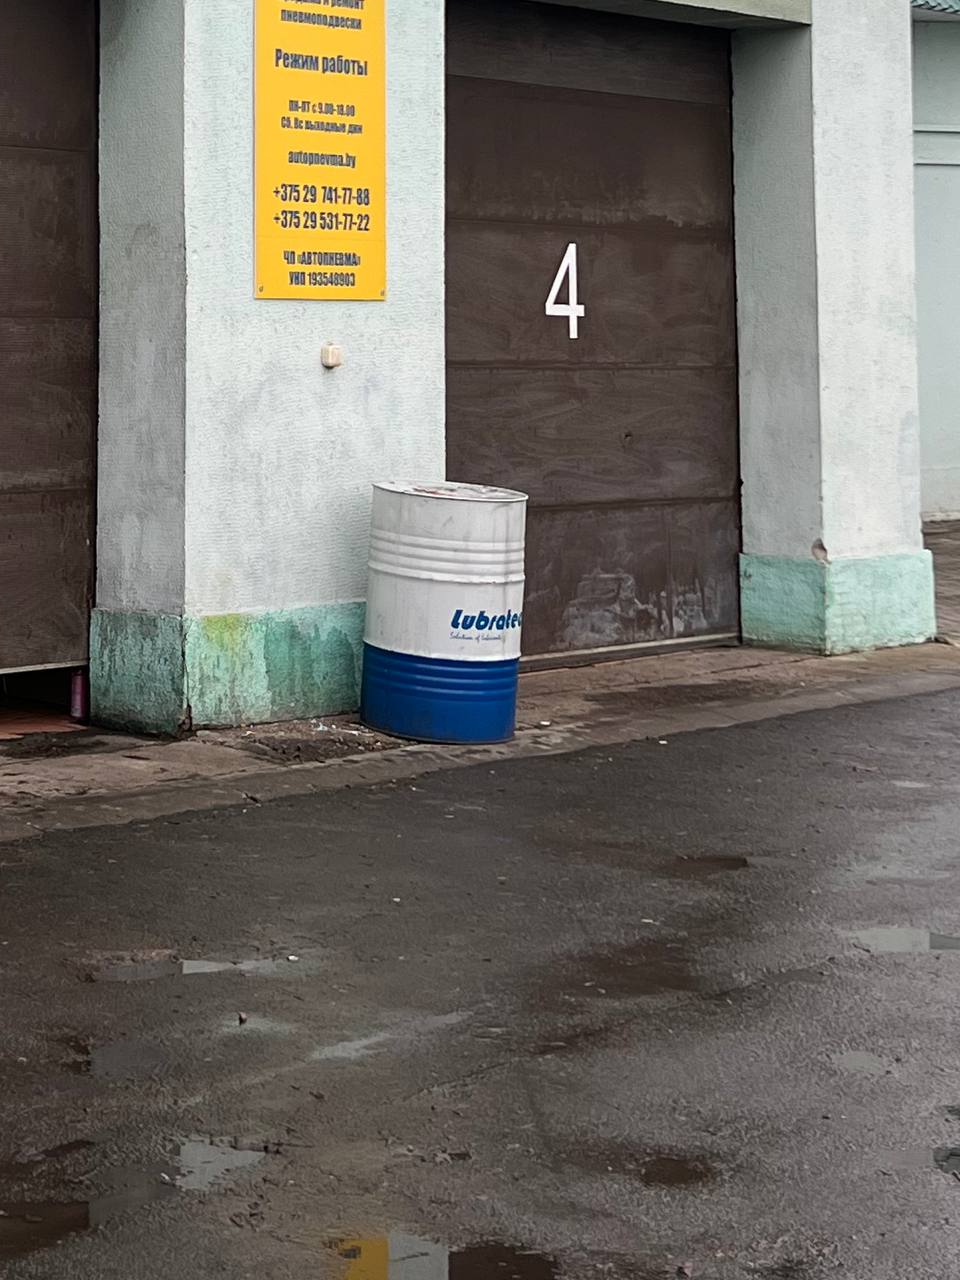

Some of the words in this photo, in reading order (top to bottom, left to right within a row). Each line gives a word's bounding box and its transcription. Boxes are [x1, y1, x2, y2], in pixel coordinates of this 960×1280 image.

[280, 9, 362, 30] пневмоподвески
[275, 48, 320, 71] Режим
[322, 55, 368, 76] работы
[304, 120, 346, 134] выходные
[347, 123, 363, 135] дни
[288, 150, 356, 168] autopnevma.by
[273, 183, 300, 203] +375
[302, 185, 317, 203] 29
[321, 186, 370, 206] 741-77-88
[273, 210, 300, 229] +375
[303, 211, 317, 230] 29
[319, 212, 370, 231] 531-77-22
[283, 250, 295, 265] ЧП
[289, 271, 306, 286] УНП
[545, 243, 585, 338] 4
